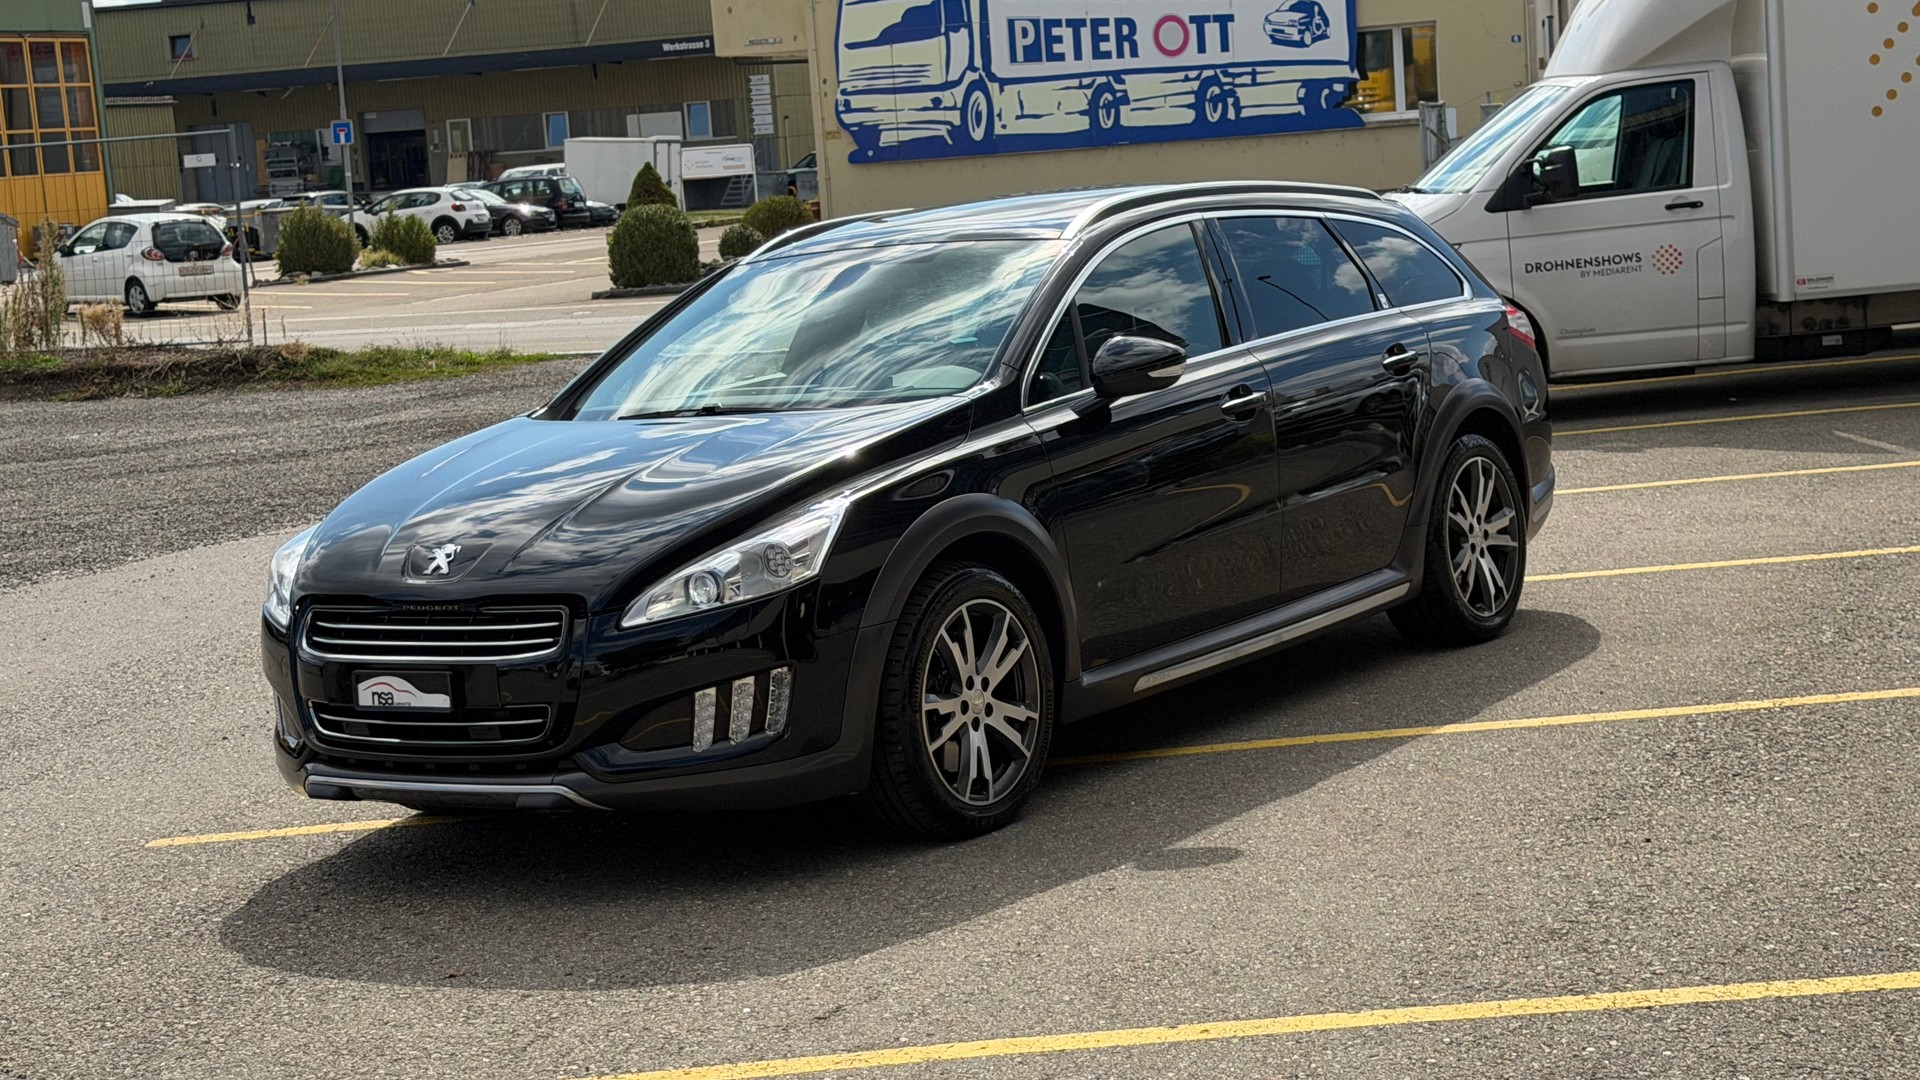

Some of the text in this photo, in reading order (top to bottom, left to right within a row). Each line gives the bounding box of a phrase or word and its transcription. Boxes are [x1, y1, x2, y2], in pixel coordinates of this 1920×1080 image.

[662, 39, 711, 52] Werkstrasse 3
[1007, 14, 1235, 63] PETER OTT
[1525, 252, 1642, 274] DROHNENSHOWS
[1580, 265, 1642, 279] BY MEDIARENT
[371, 691, 395, 706] nsa
